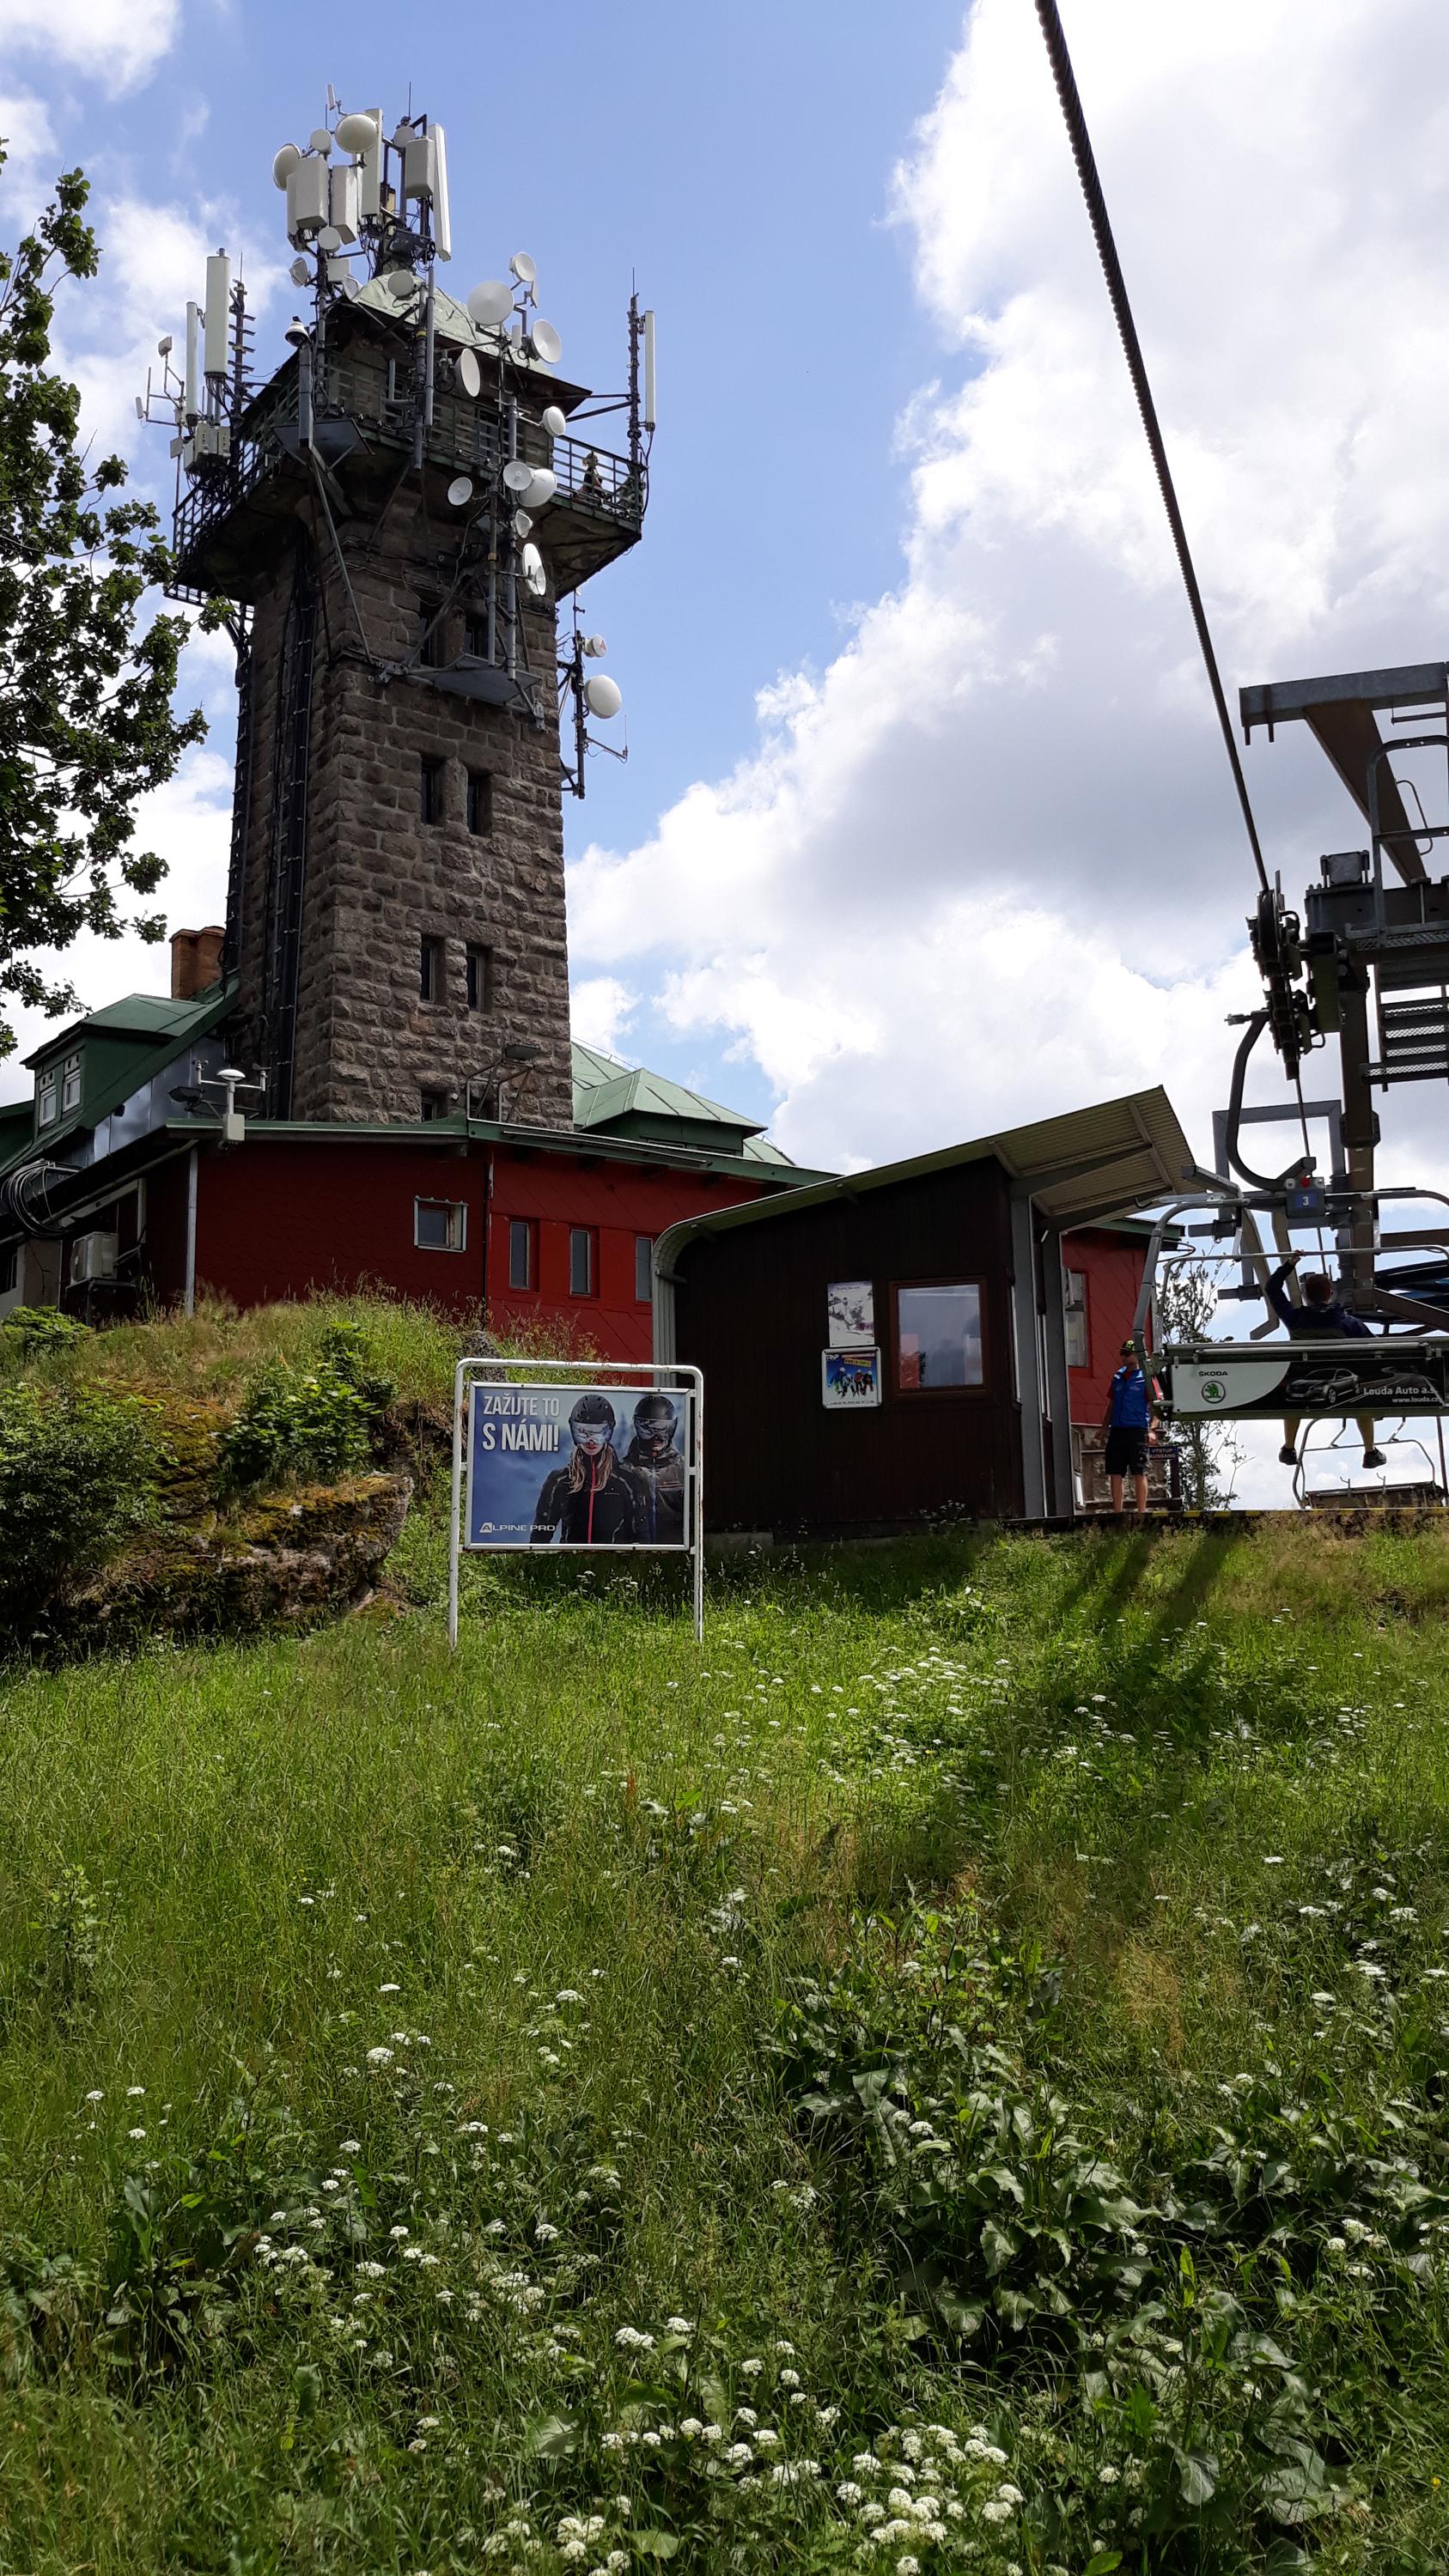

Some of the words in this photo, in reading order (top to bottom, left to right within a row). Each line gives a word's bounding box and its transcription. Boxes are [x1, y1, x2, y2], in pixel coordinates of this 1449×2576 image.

[1302, 1196, 1309, 1206] 3
[1363, 1386, 1392, 1395] Louda
[484, 1393, 538, 1415] ZAŽIJTE
[542, 1397, 559, 1416] TO
[483, 1422, 496, 1450] S
[502, 1419, 559, 1451] NÁMI!
[479, 1522, 527, 1533] ALPINE
